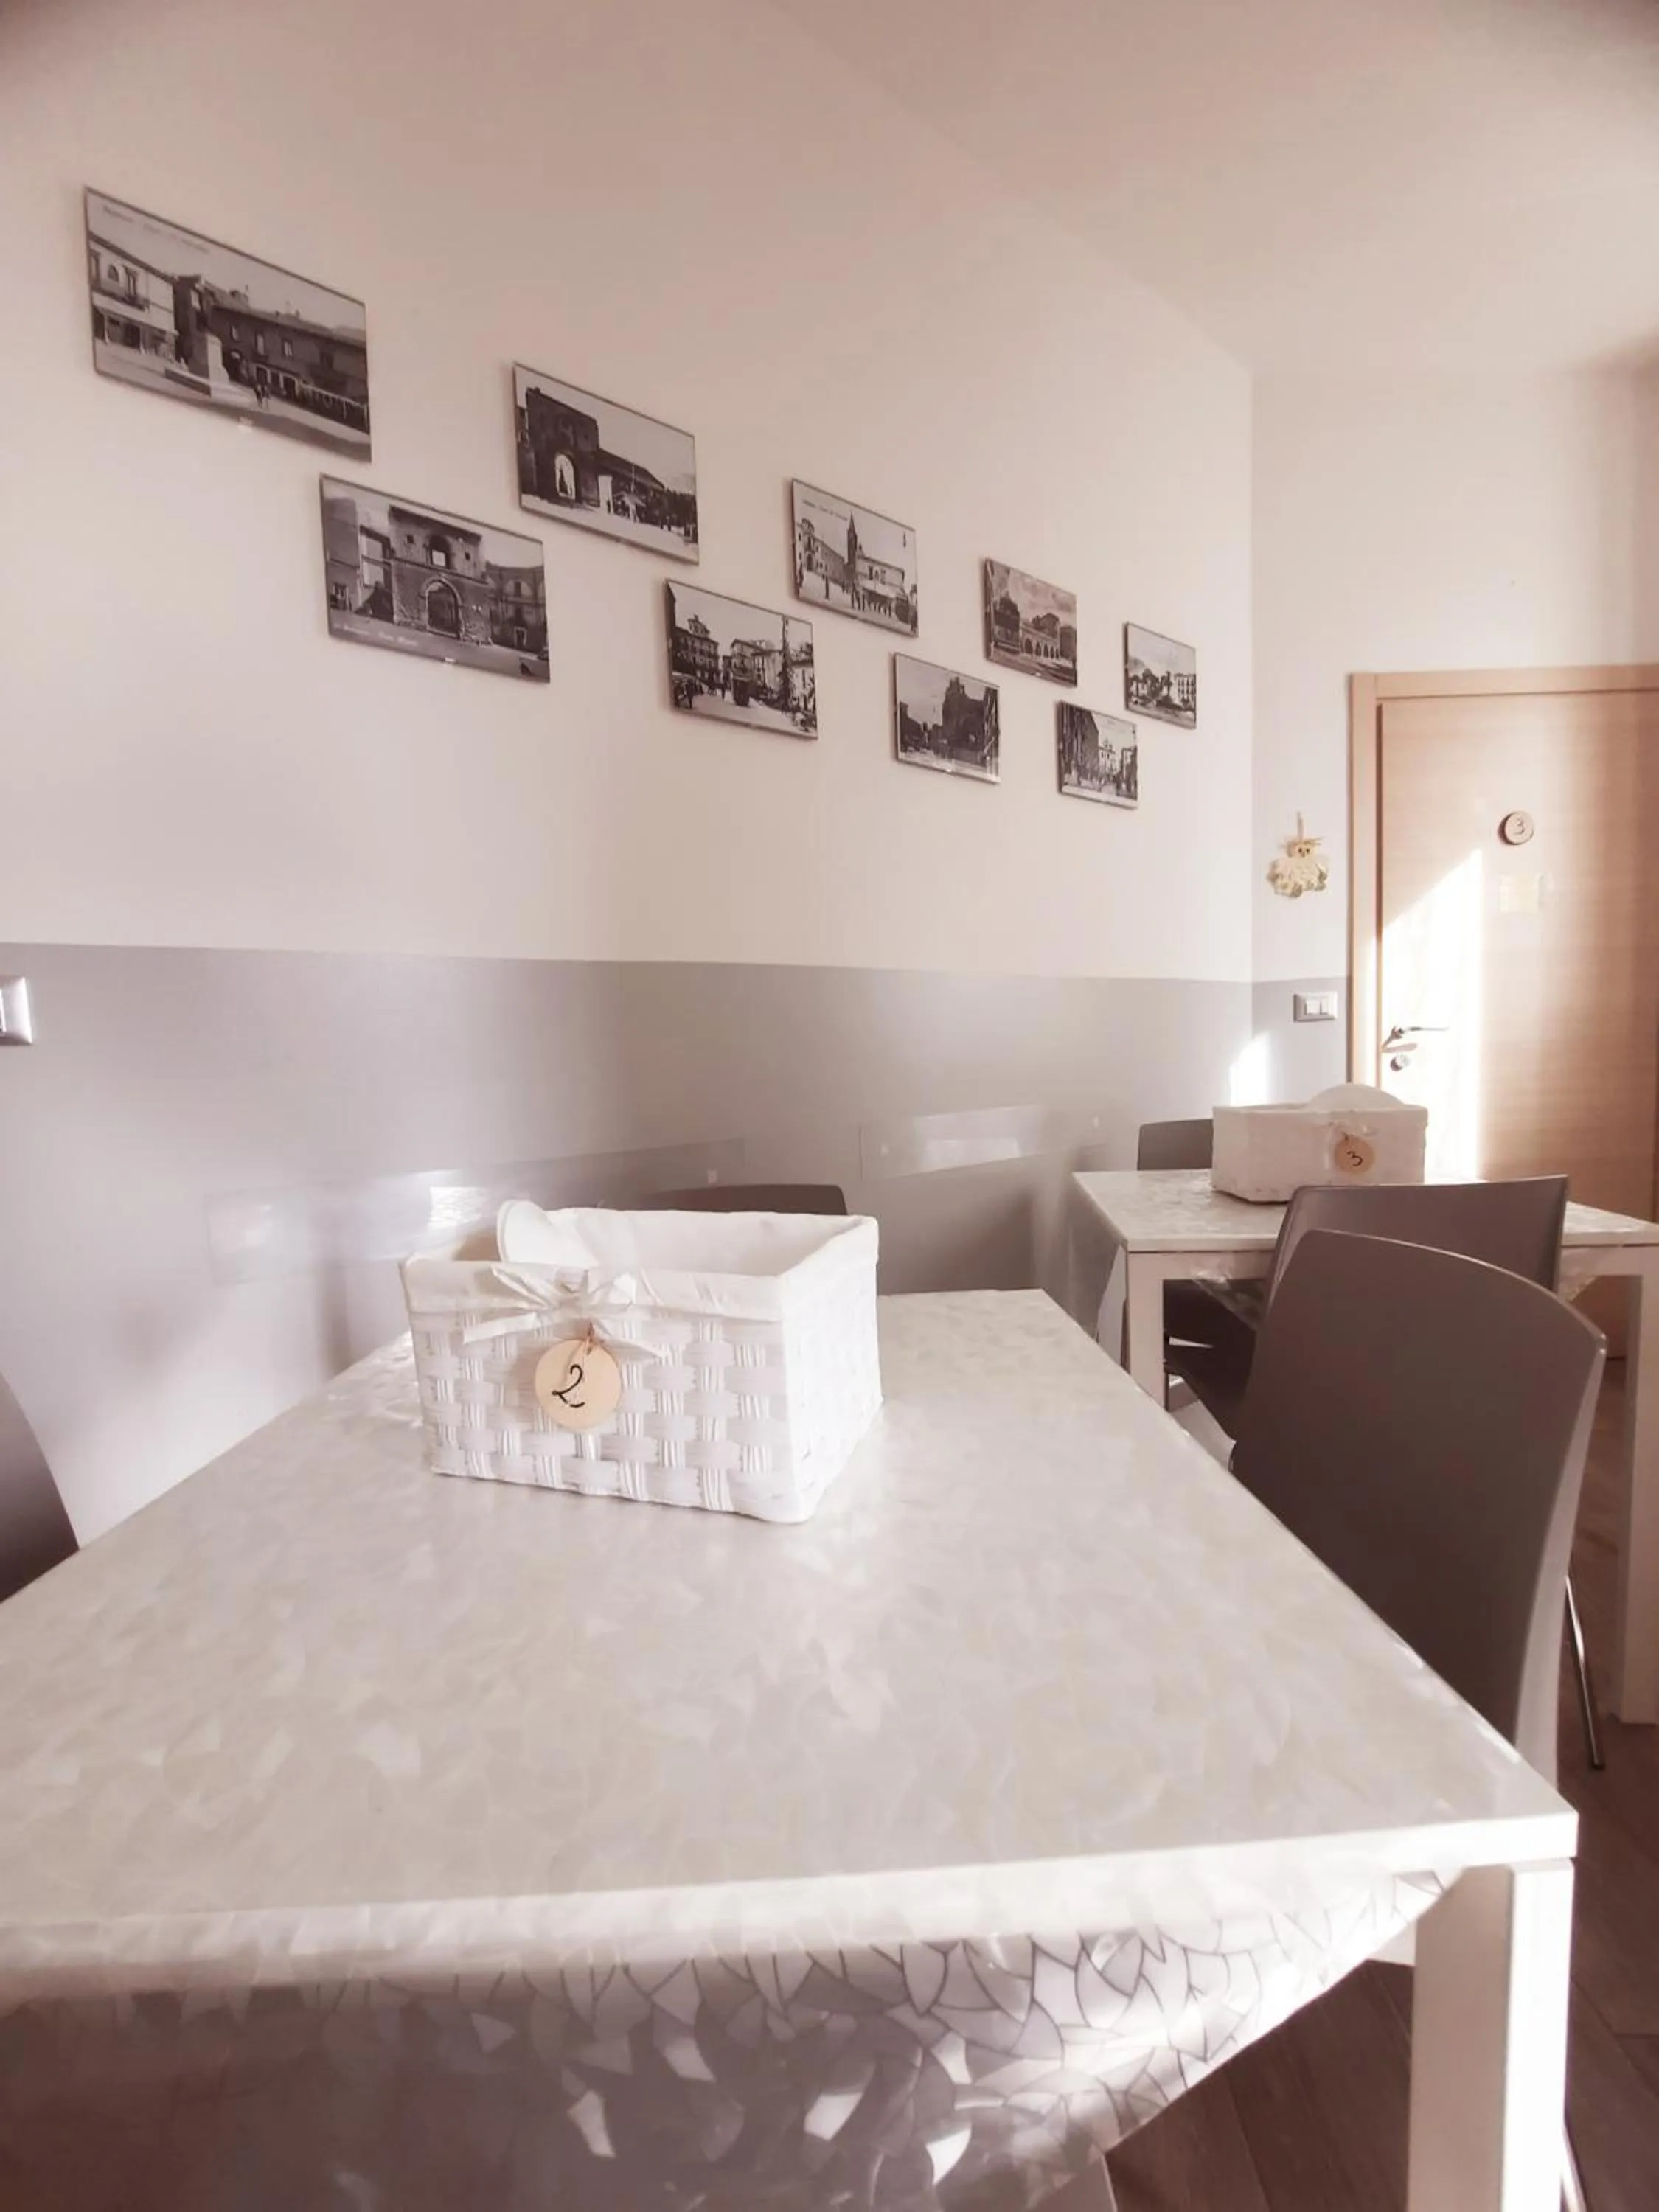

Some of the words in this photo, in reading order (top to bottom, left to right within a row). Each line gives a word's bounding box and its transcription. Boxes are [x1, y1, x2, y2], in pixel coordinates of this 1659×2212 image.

[1513, 817, 1526, 835] 3
[1346, 1150, 1363, 1167] 3
[552, 1363, 585, 1408] 2
